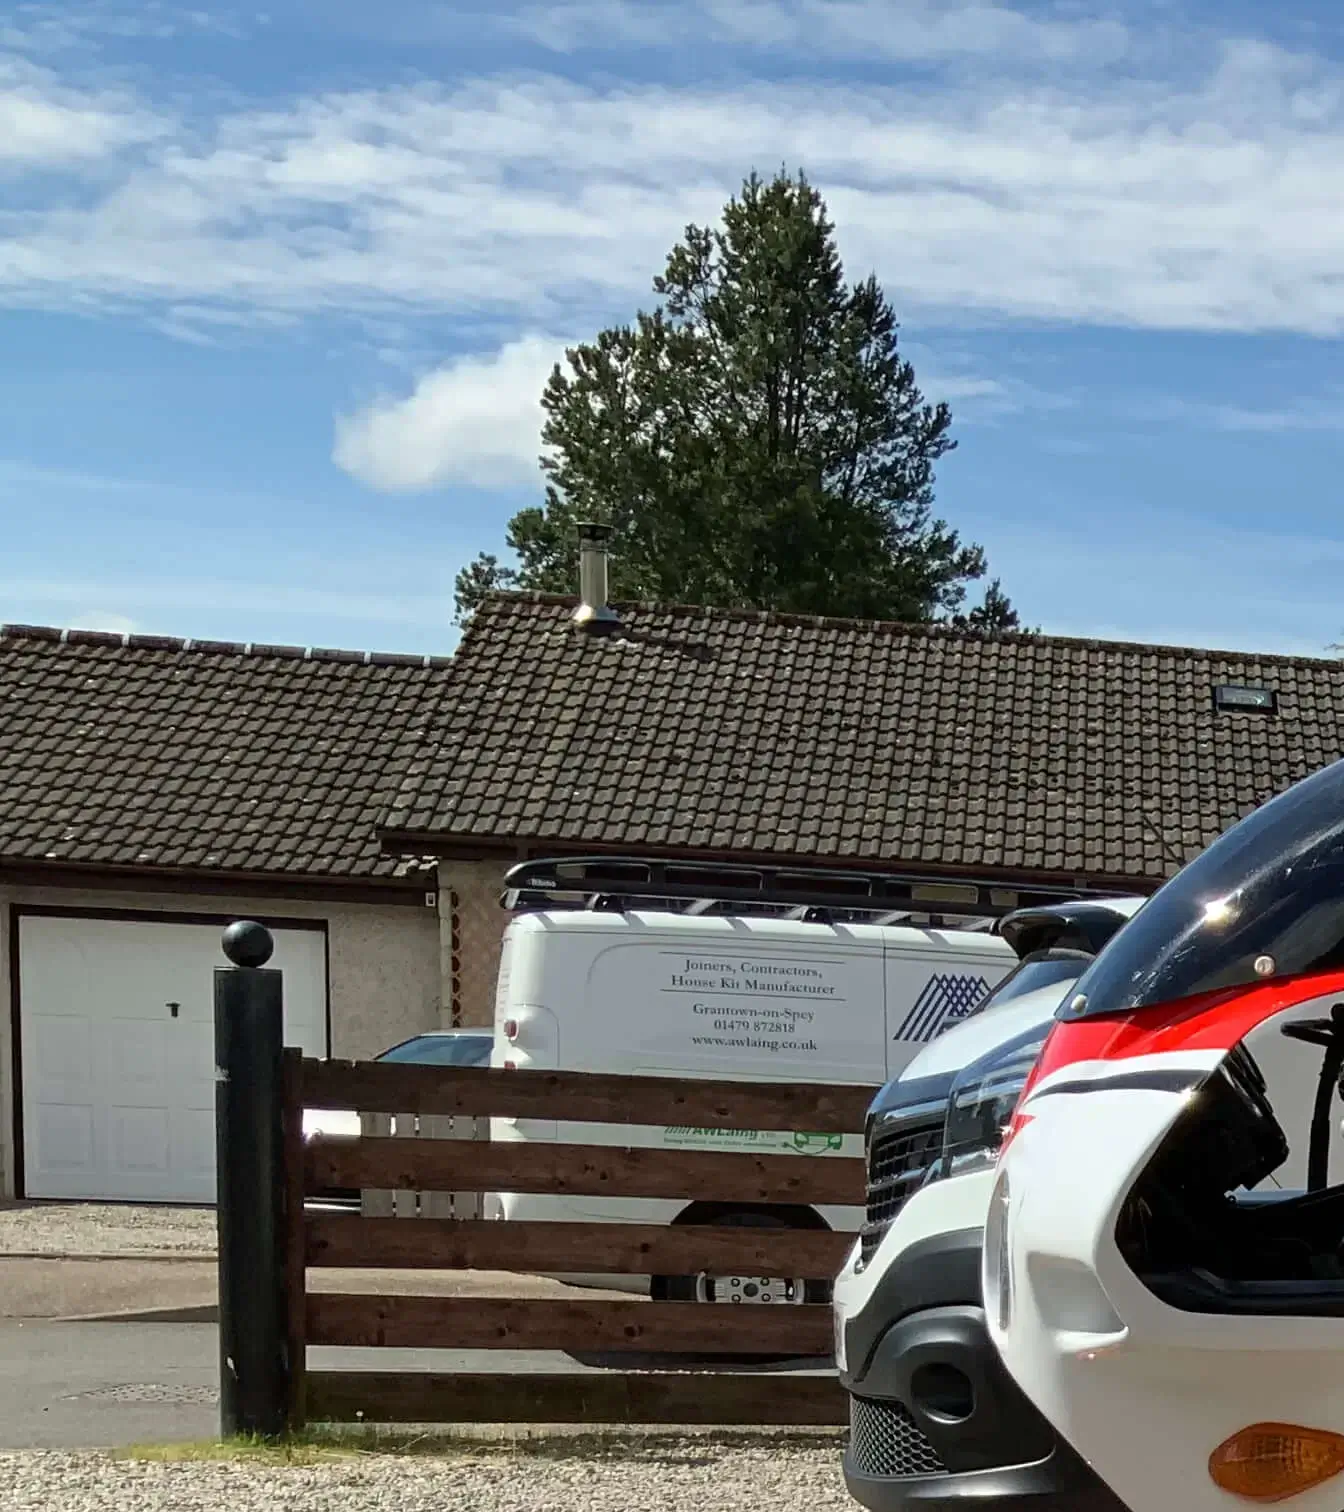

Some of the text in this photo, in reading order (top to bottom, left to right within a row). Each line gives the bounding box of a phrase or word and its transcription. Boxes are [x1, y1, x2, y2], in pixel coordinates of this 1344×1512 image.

[684, 959, 823, 979] Joiners, Contractors,
[671, 974, 836, 994] House Kit Manufacturer
[692, 1003, 815, 1023] Grantown-on-Spey
[713, 1019, 796, 1033] 01479 872818
[691, 1034, 817, 1052] www.awlaing.co.uk
